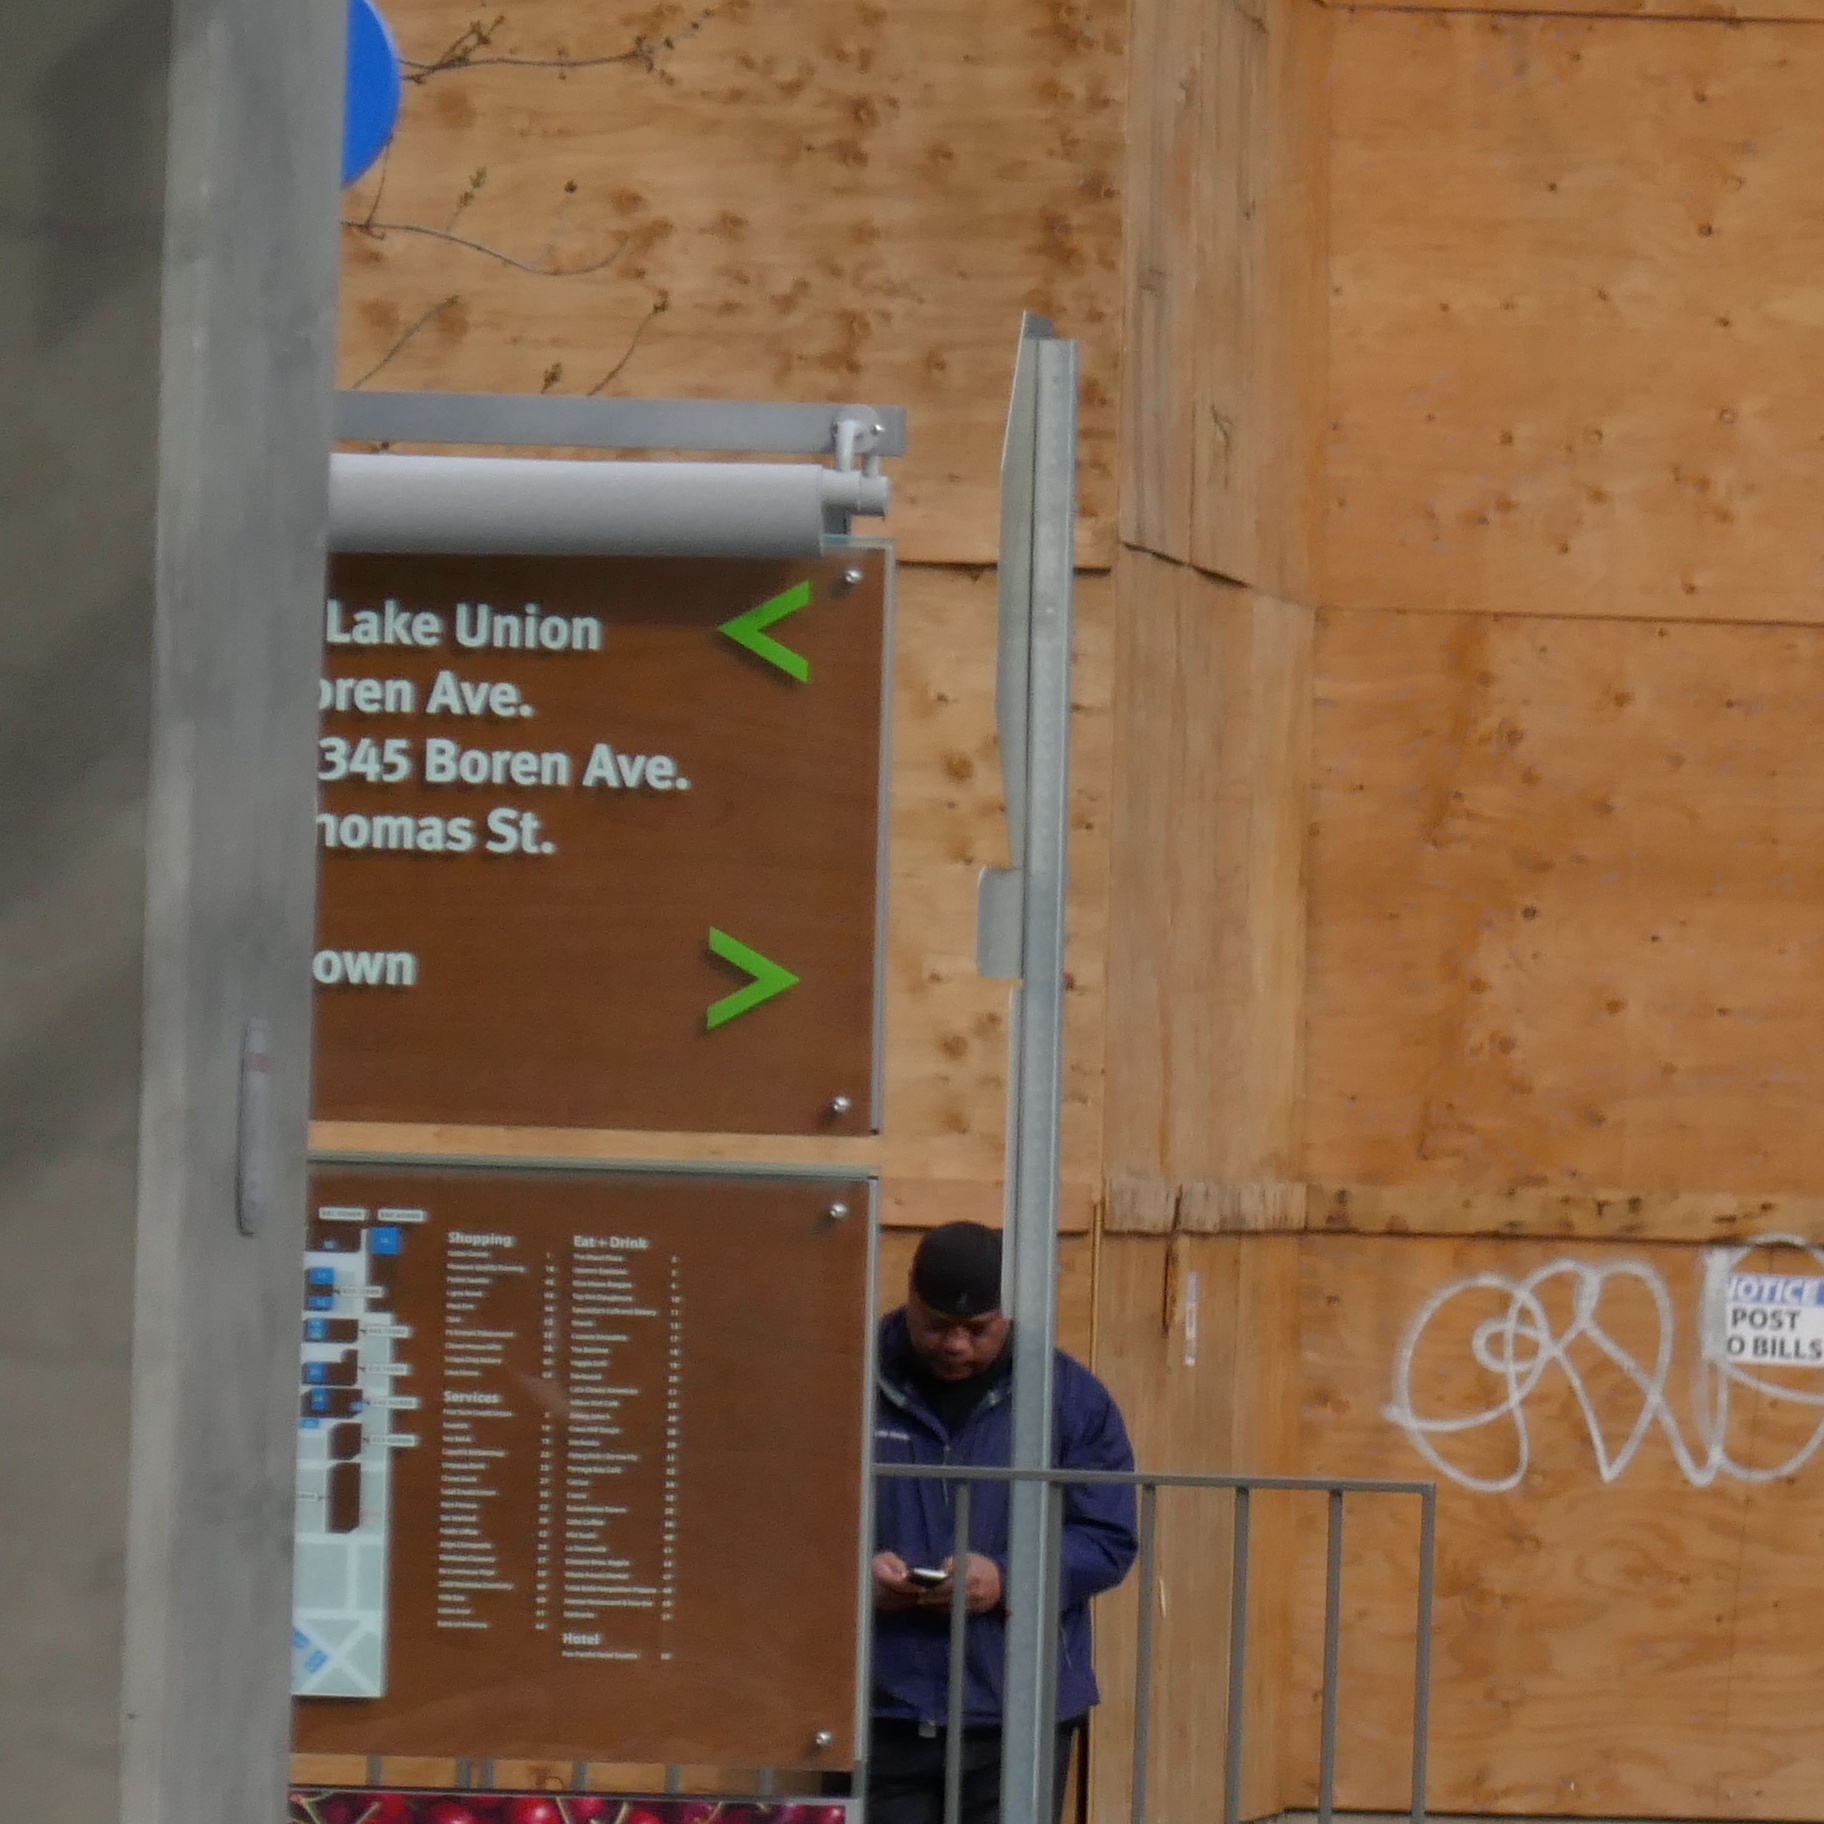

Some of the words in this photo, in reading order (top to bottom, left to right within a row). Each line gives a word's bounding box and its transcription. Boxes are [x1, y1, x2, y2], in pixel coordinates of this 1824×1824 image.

[326, 599, 443, 645] Lake
[455, 603, 602, 651] Union
[425, 670, 535, 717] Ave.
[318, 736, 411, 782] 345
[425, 738, 571, 785] Boren
[582, 743, 692, 790] Ave.
[485, 807, 557, 854] St.
[448, 1232, 514, 1248] Shopping
[573, 1235, 595, 1248] Eat
[610, 1236, 649, 1249] Drink
[1731, 1308, 1800, 1331] POST
[1753, 1336, 1823, 1360] BILLS
[444, 1390, 500, 1404] Services
[562, 1632, 600, 1645] Hotel
